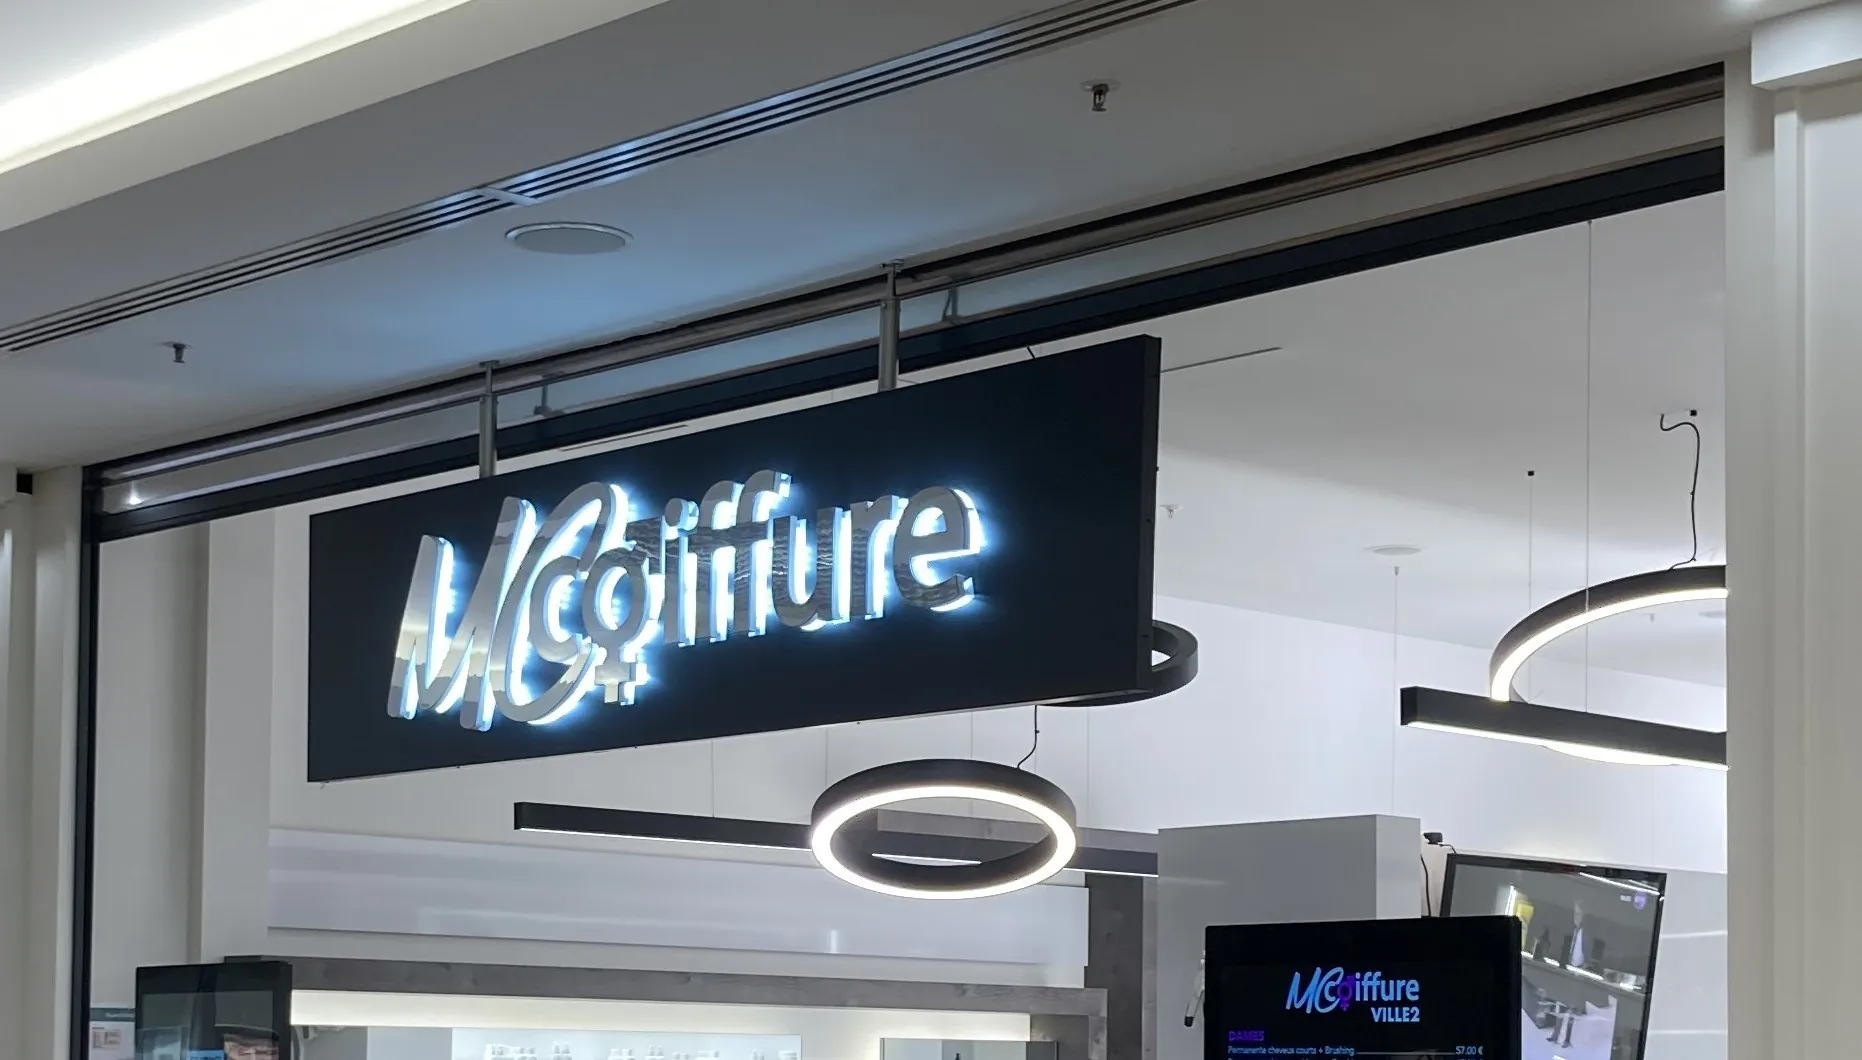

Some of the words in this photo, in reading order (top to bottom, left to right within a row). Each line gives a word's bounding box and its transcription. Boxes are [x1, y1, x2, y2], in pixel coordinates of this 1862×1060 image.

[1371, 1007, 1420, 1022] VILLE2
[1228, 1031, 1265, 1041] DAMES
[1325, 1046, 1354, 1056] Brushing
